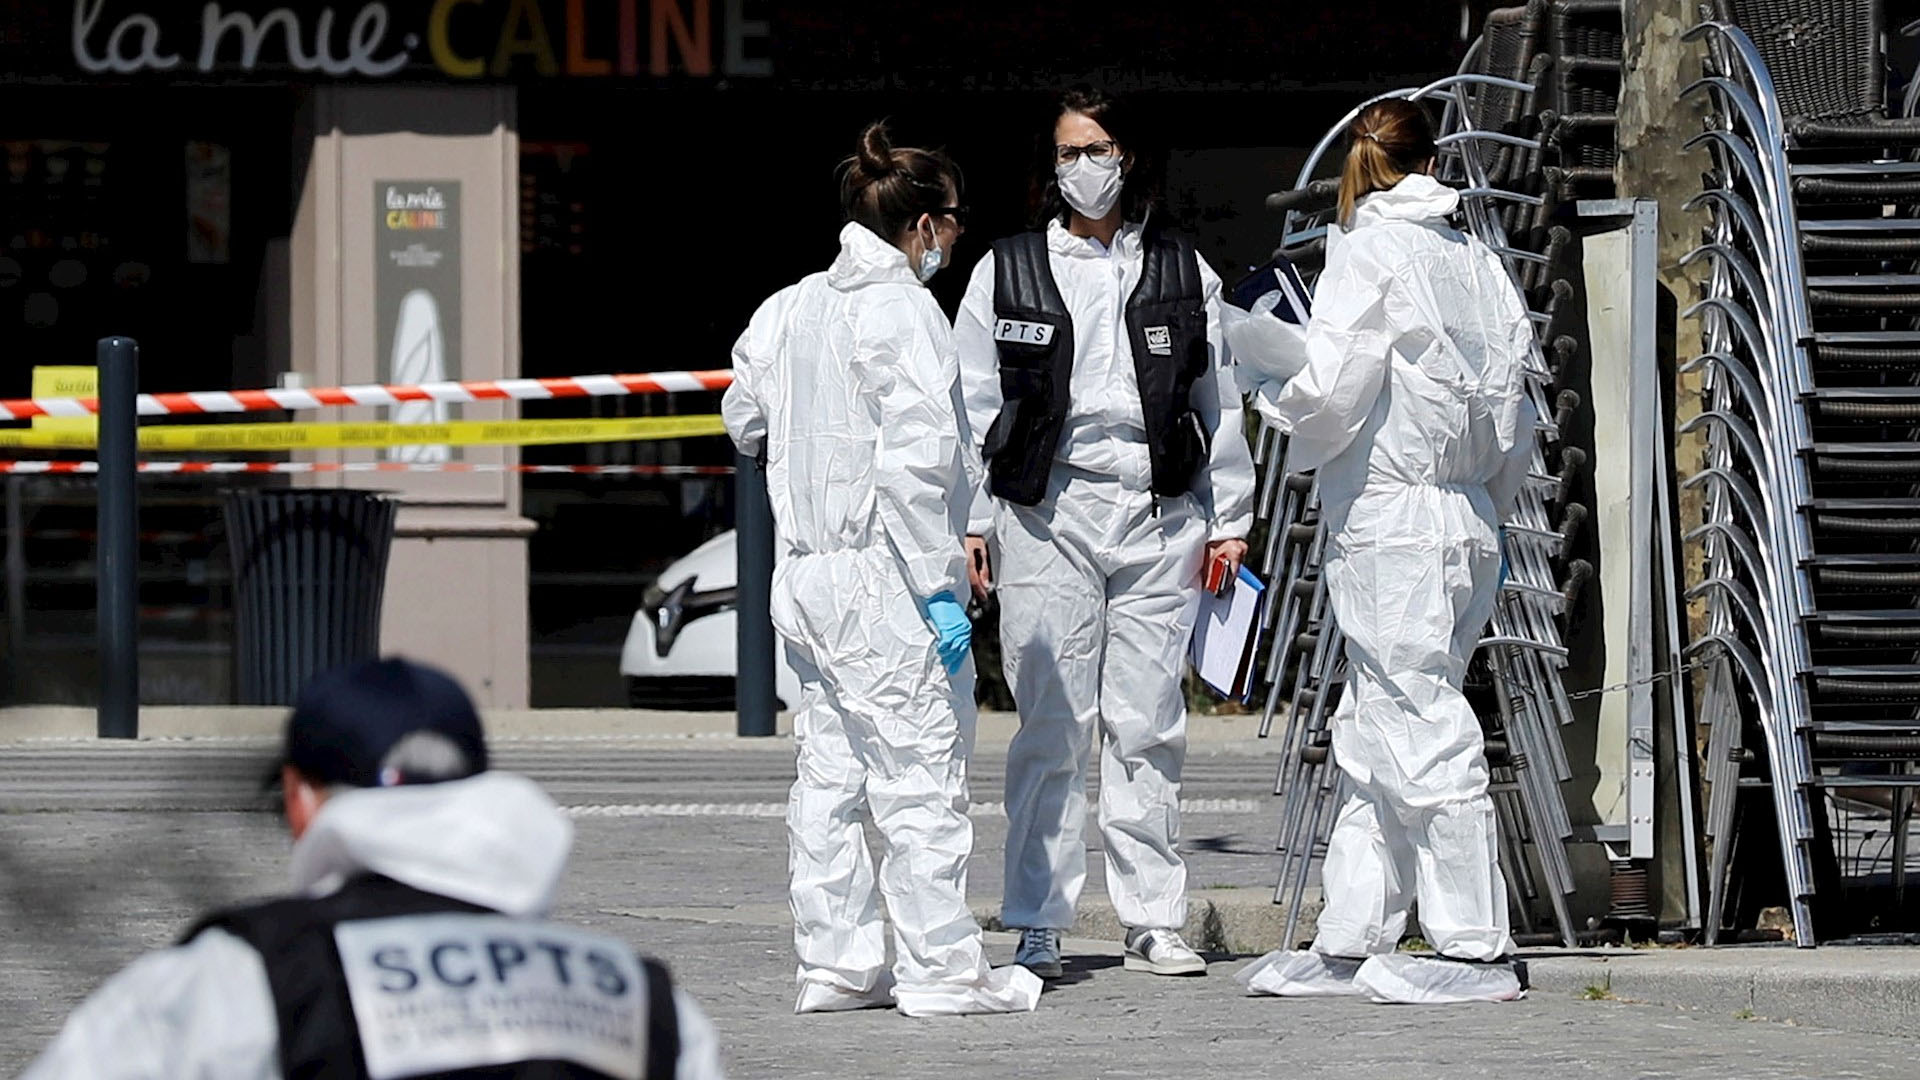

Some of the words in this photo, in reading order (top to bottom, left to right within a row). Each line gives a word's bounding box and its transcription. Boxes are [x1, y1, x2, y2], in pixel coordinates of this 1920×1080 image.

[73, 0, 179, 72] la
[429, 0, 774, 77] CALINE
[386, 211, 447, 229] CALINE
[370, 937, 630, 997] SCPTS
